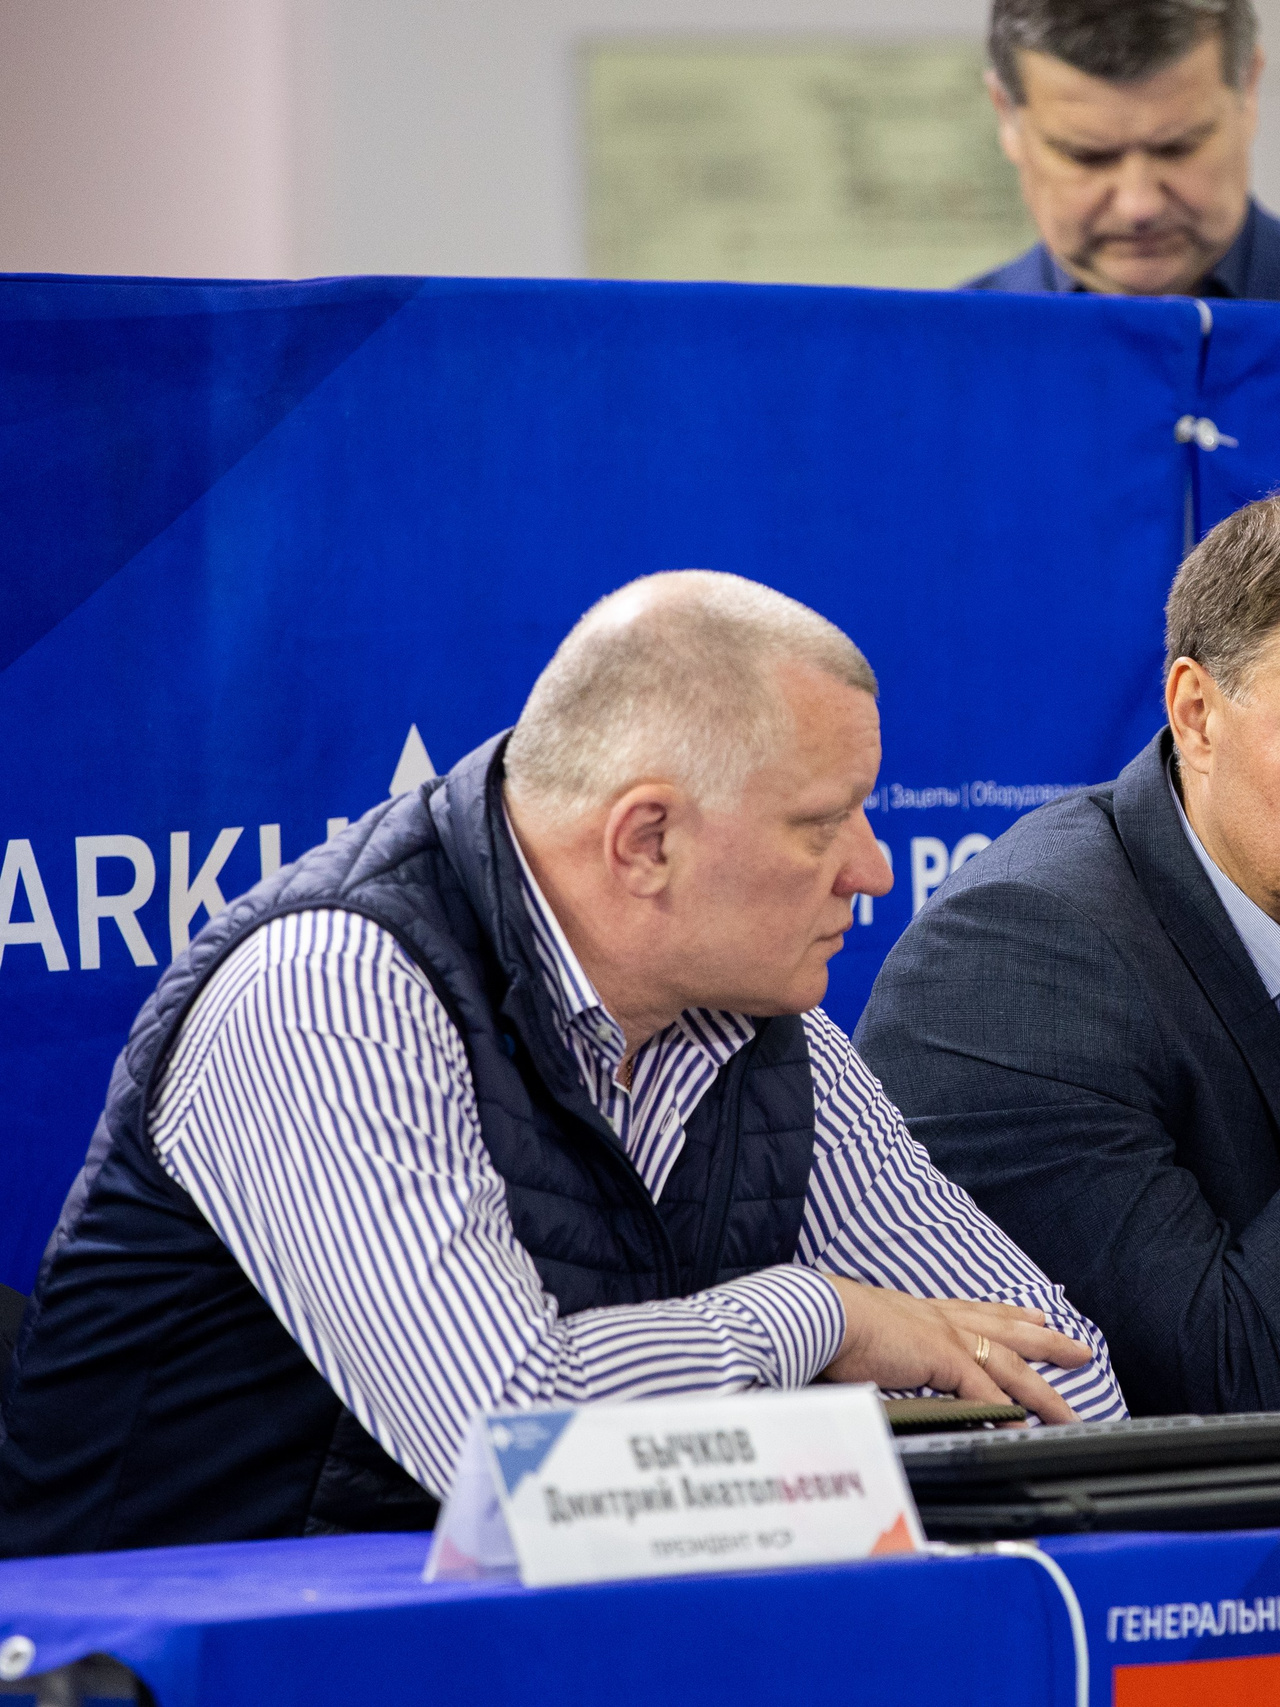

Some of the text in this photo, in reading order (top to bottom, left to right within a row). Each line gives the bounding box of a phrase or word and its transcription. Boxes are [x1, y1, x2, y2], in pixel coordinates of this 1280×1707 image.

[629, 1429, 756, 1471] БЫЧКОВ
[544, 1471, 865, 1525] Дмитрий Анатольевич
